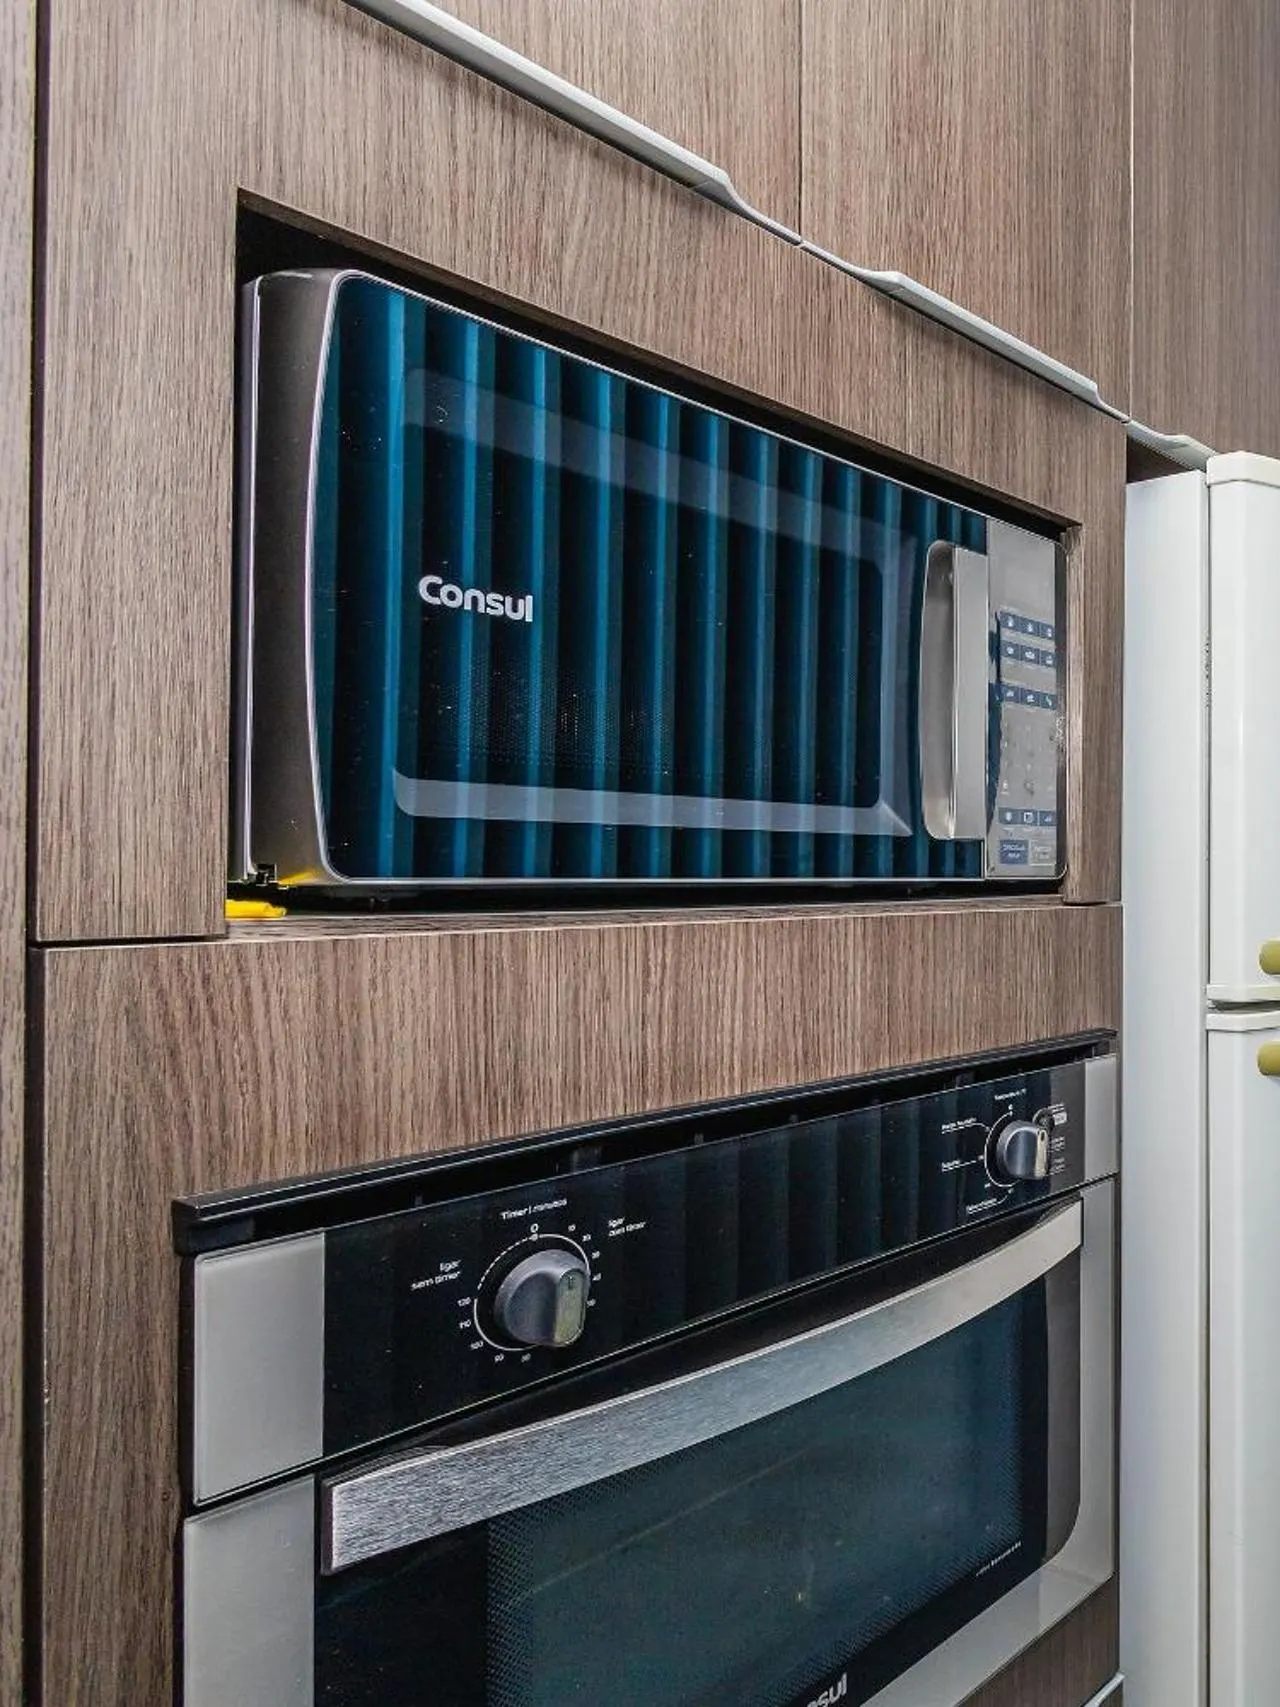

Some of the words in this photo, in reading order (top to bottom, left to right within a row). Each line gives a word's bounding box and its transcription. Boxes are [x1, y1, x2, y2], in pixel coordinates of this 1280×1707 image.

[418, 574, 533, 622] Consul
[501, 1208, 528, 1220] Timer
[530, 1223, 539, 1233] 0
